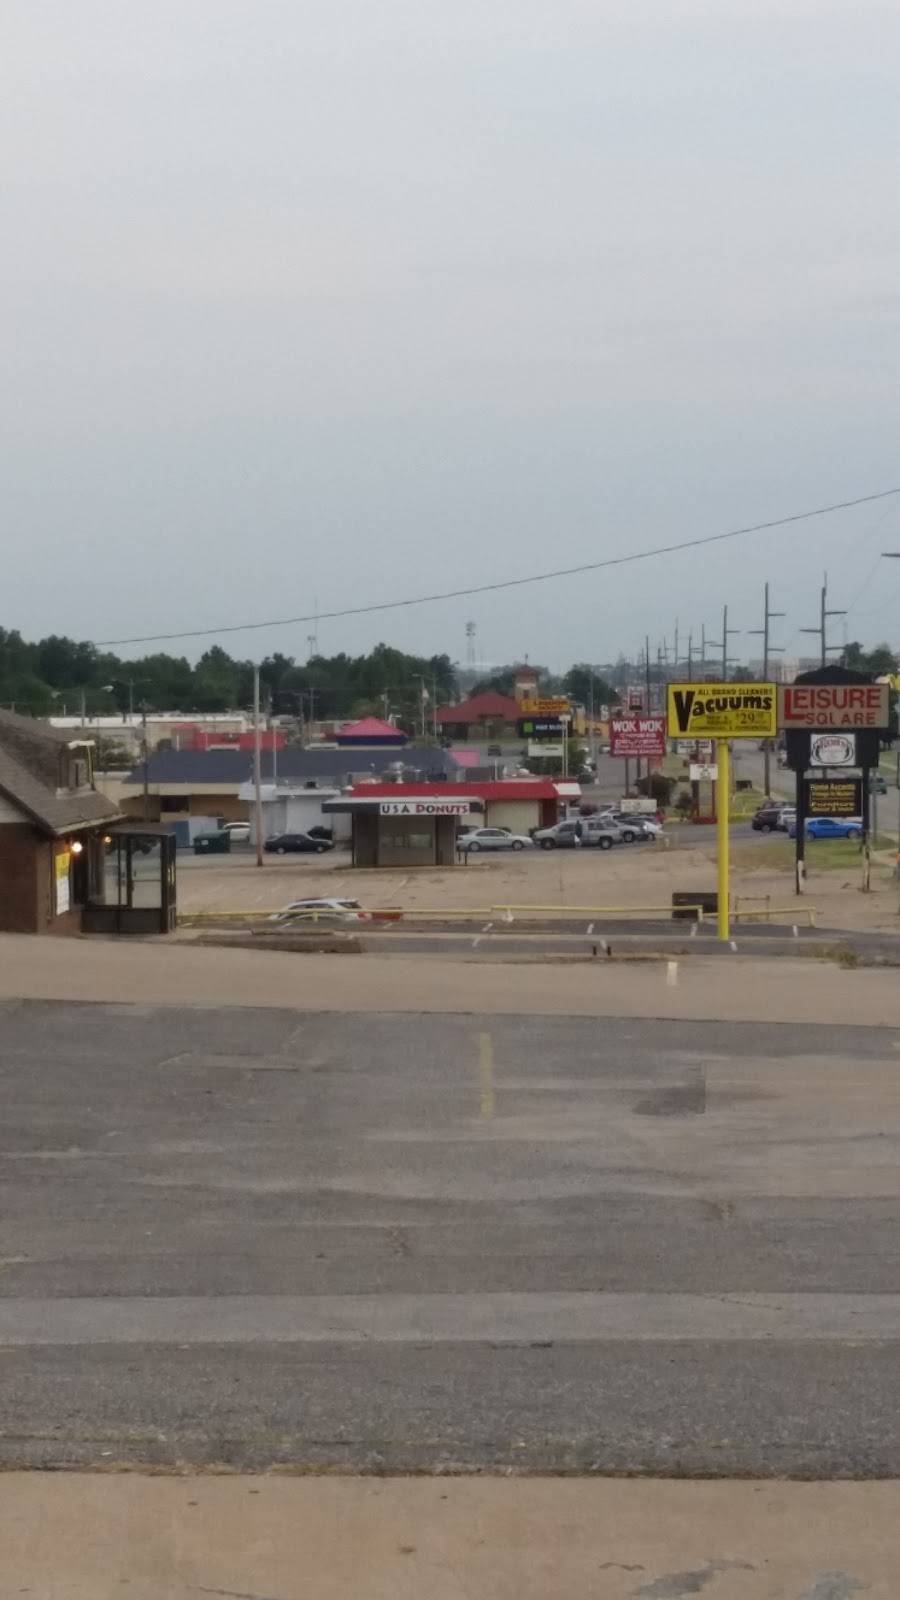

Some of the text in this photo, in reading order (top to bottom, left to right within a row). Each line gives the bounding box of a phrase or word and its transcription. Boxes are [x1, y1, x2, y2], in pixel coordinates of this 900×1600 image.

[673, 690, 773, 732] Vacuums
[784, 688, 882, 720] LEISURE
[612, 719, 663, 732] WOK WOK
[415, 803, 469, 814] DONUTS
